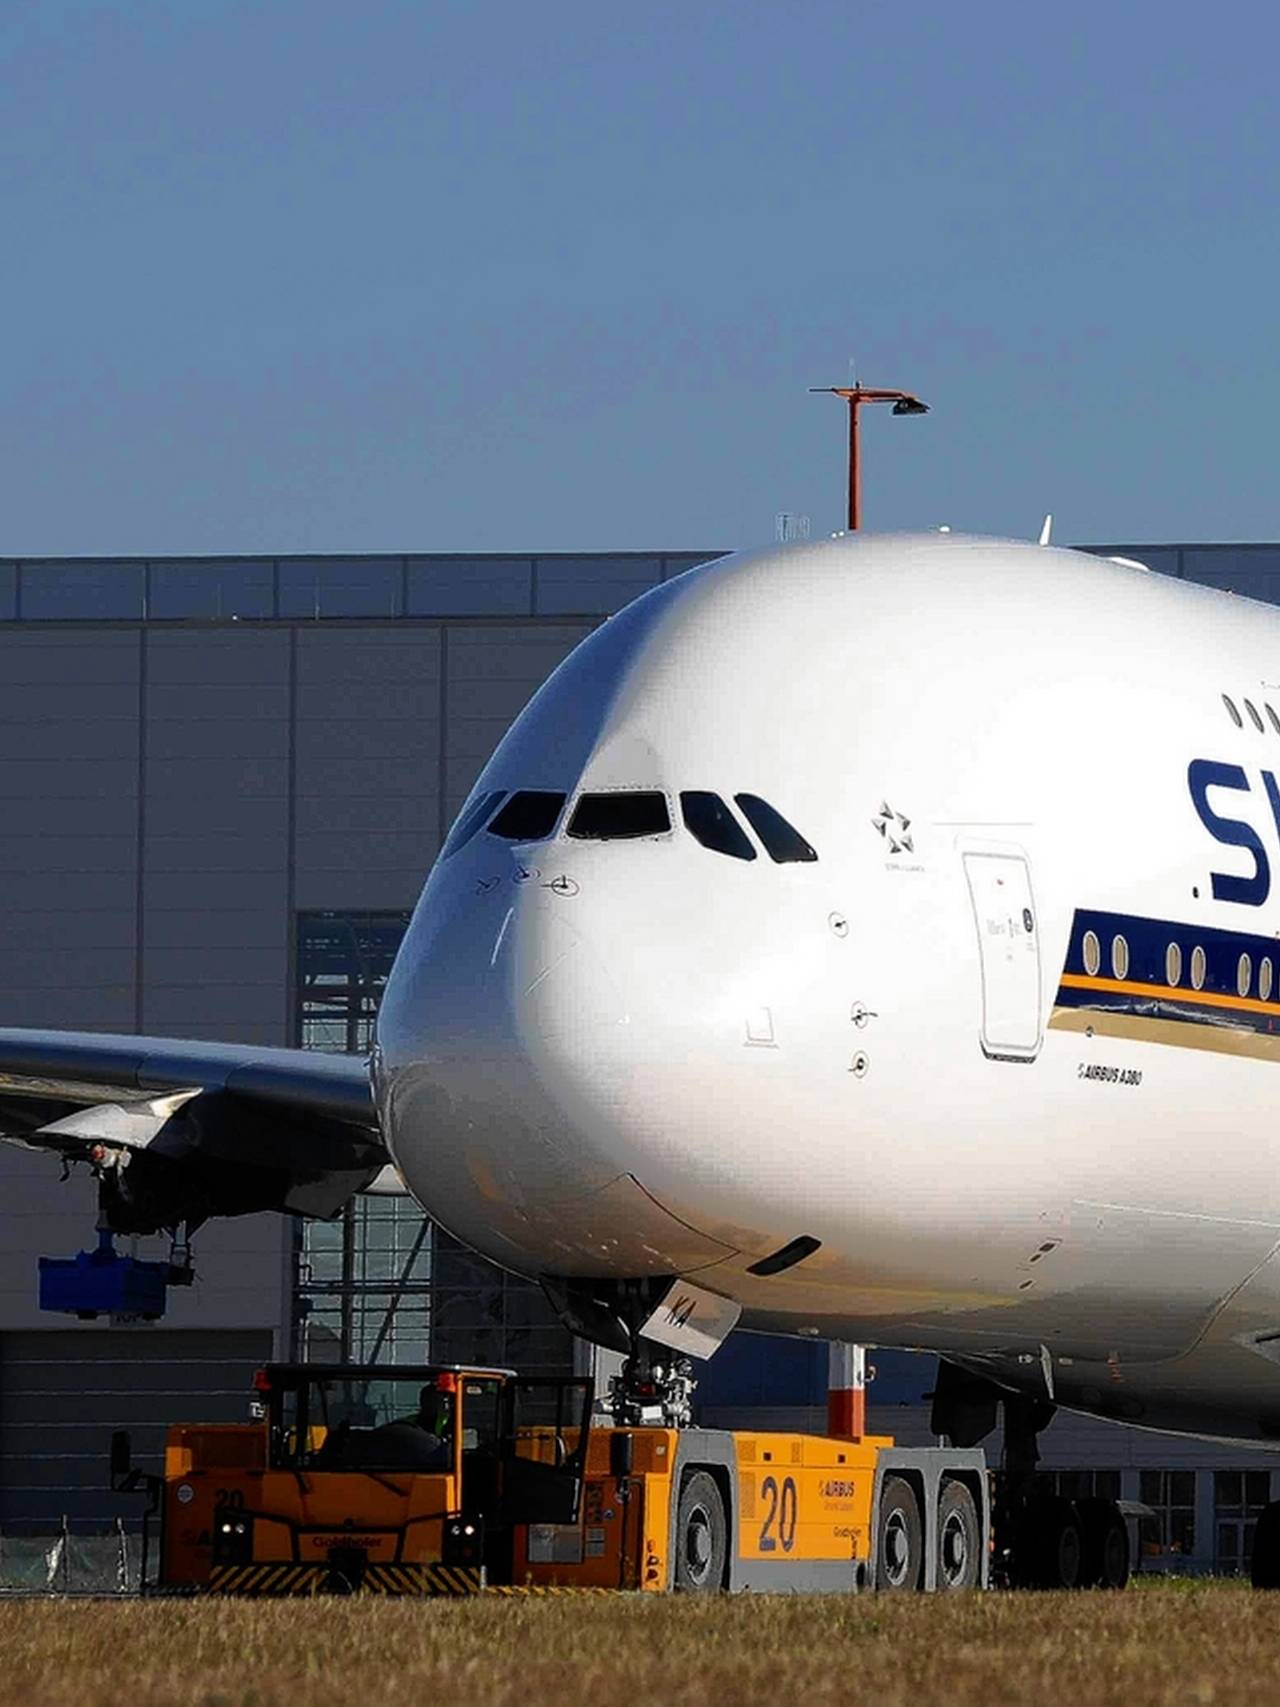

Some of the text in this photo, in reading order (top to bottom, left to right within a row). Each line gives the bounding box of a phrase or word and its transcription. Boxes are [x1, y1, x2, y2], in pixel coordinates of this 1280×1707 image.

[1084, 1064, 1142, 1086] AIRBUS A380
[825, 1480, 855, 1498] AIRBUS
[759, 1476, 797, 1553] 20
